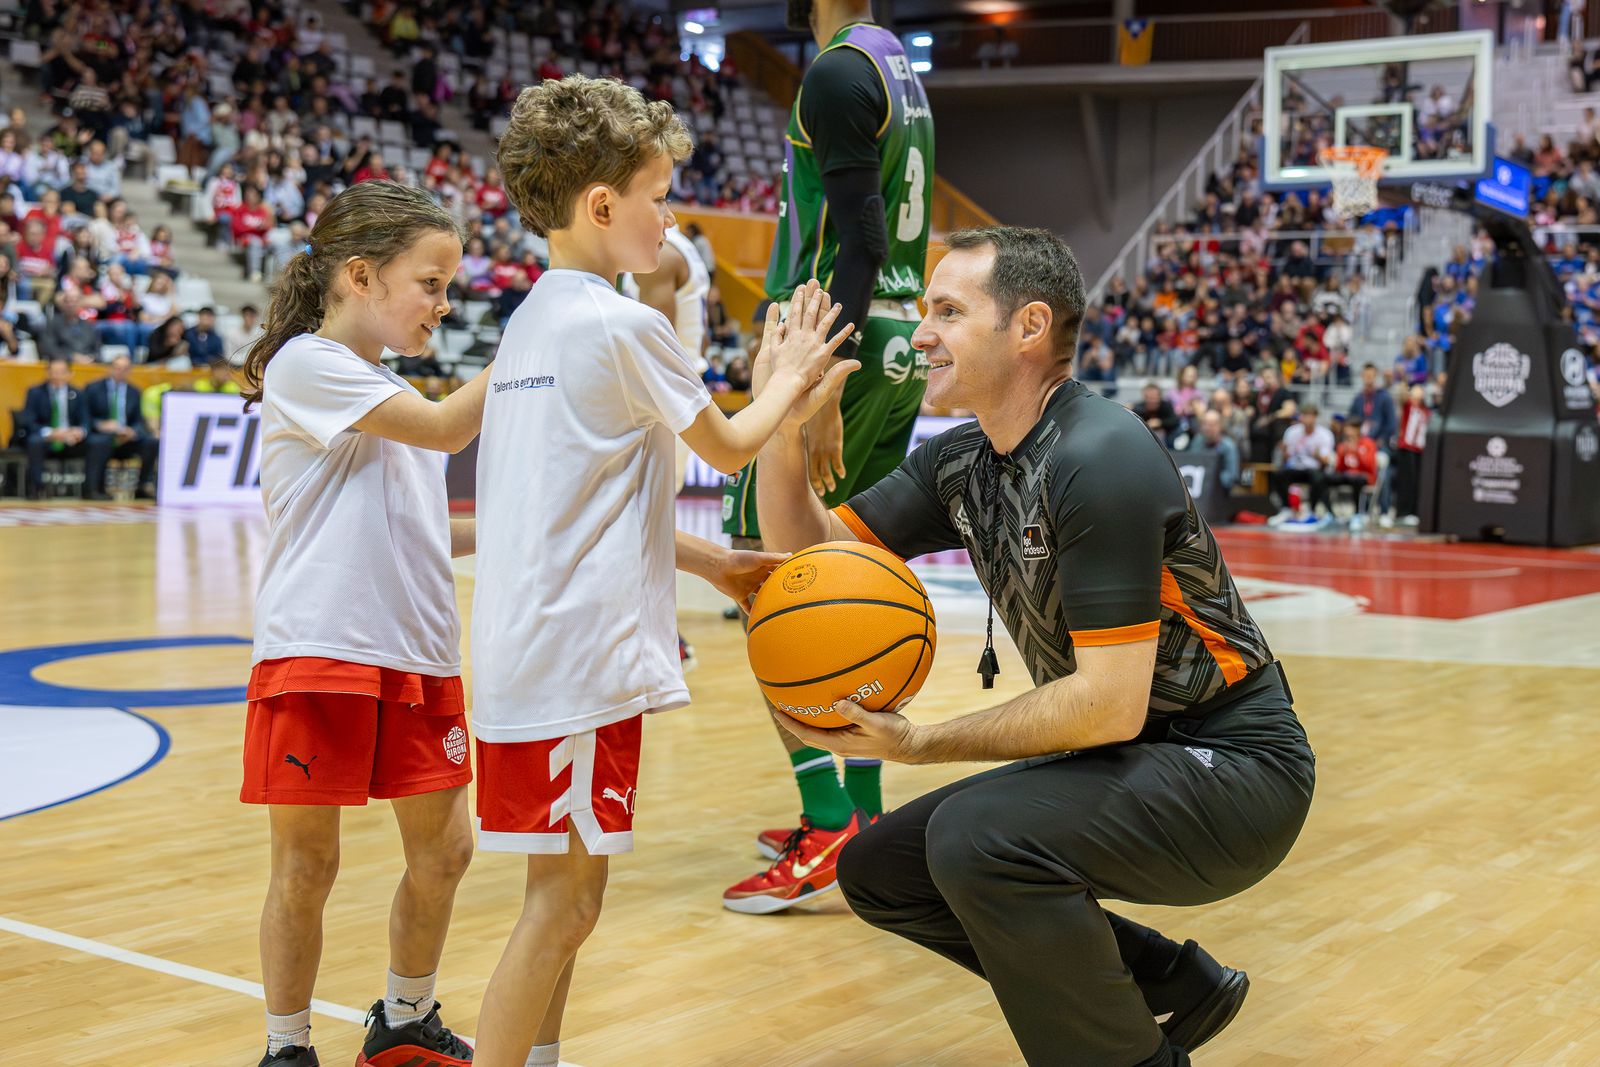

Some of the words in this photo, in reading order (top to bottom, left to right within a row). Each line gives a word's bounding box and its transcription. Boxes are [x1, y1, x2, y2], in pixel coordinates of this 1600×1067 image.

[896, 146, 925, 242] 3
[493, 380, 513, 394] Talent
[513, 378, 520, 389] is
[520, 375, 555, 388] everywere
[180, 414, 261, 488] FI
[1024, 545, 1046, 555] endesa
